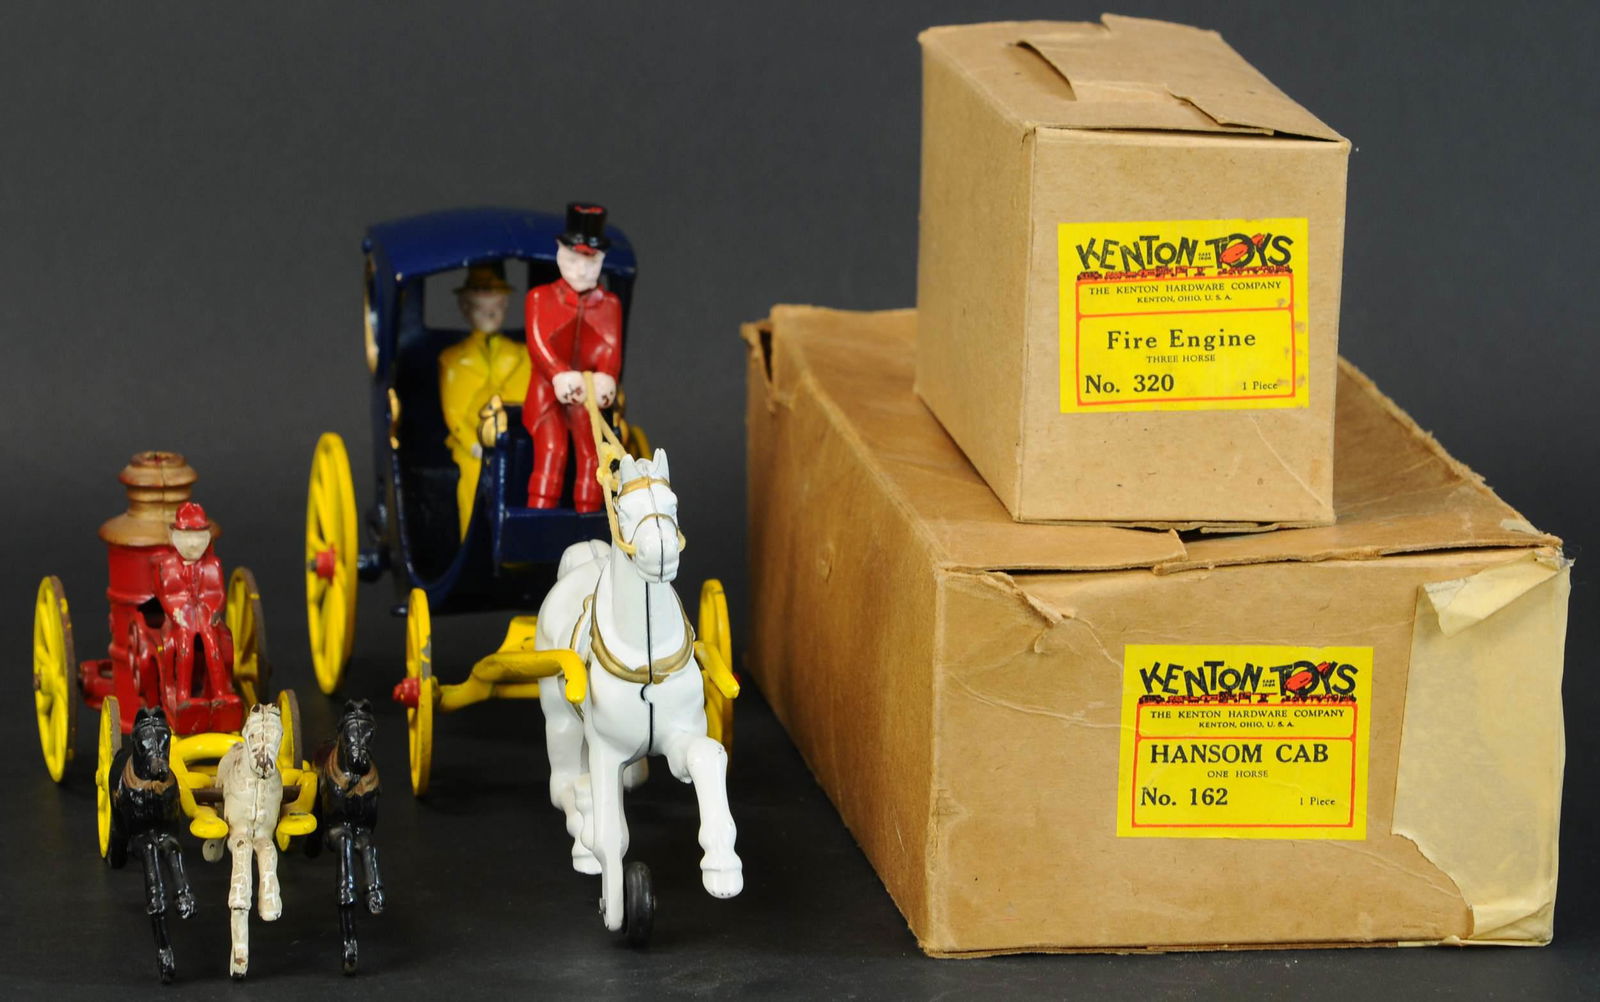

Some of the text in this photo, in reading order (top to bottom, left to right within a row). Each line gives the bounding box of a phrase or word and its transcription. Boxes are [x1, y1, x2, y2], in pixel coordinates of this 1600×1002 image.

[1076, 233, 1294, 271] KENTON TOYS
[1089, 281, 1282, 295] THE KENTON HARDWARE COMPANY
[1107, 328, 1256, 351] Fire Engine
[1146, 354, 1215, 363] THREE HORSE
[1085, 374, 1174, 393] No. 320
[1243, 381, 1278, 390] 1 Piece
[1139, 660, 1358, 697] KENTON TOYS
[1228, 710, 1287, 718] HARDWARE
[1294, 709, 1345, 717] COMPANY
[1150, 744, 1329, 764] HANSOM CAB
[1207, 770, 1268, 778] ONE HORSE
[1141, 788, 1228, 806] No. 162
[1310, 797, 1335, 805] Piece
